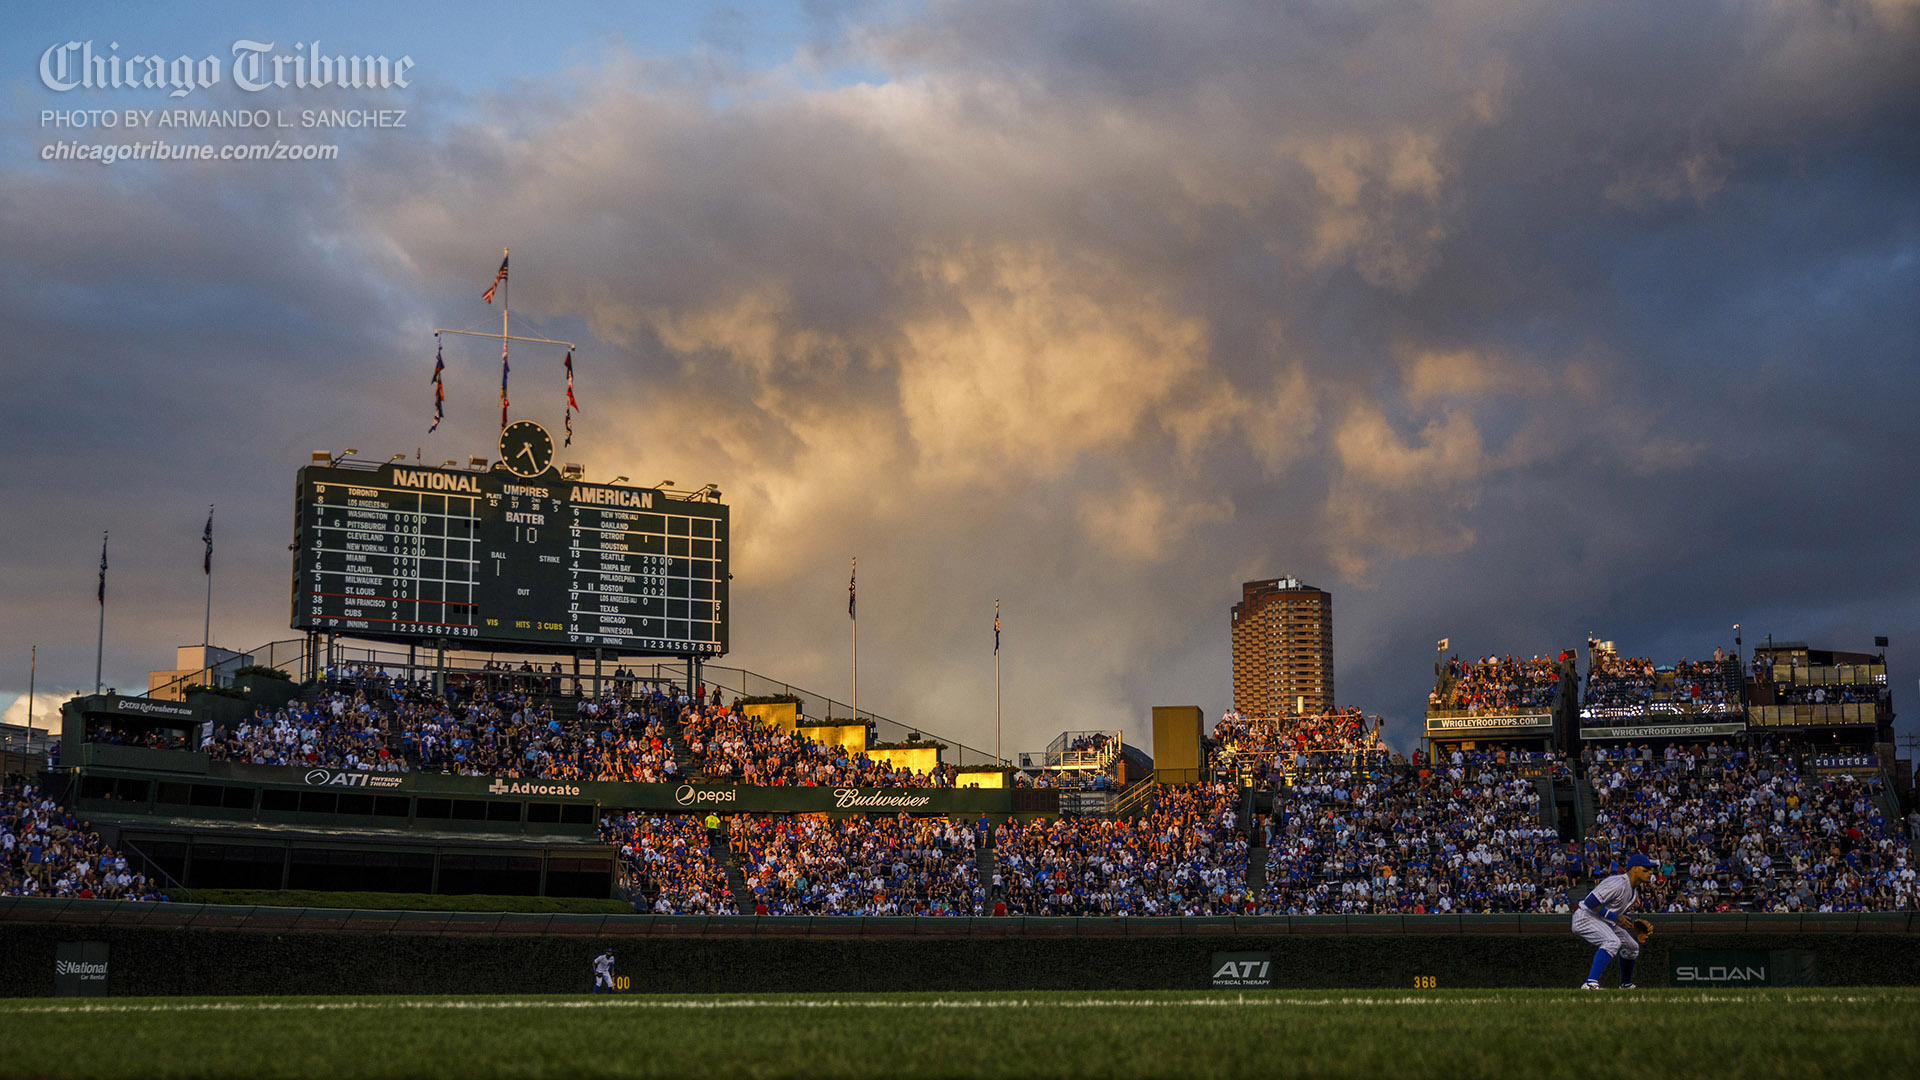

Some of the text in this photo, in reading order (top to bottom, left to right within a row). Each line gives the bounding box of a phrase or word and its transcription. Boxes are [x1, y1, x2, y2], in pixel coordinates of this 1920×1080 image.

[393, 469, 481, 493] NATIONAL
[316, 485, 378, 497] 10 TORONTO
[504, 484, 549, 498] UMPIRES
[318, 496, 324, 504] 8
[570, 486, 652, 508] AMERICAN
[348, 510, 388, 520] WASHINGTON
[574, 508, 579, 516] 6
[506, 512, 544, 525] BATTER
[347, 521, 386, 530] PITTSBURGH
[601, 522, 629, 530] OAKLAND
[347, 532, 384, 542] CLEVELAND
[601, 532, 625, 540] DETROIT
[316, 540, 322, 548] 9
[346, 543, 360, 551] NEW
[600, 543, 628, 551] HOUSTON
[346, 554, 366, 562] MIAMI
[540, 555, 560, 563] STRIKE
[572, 550, 580, 558] 13
[601, 553, 625, 561] SEATTLE
[316, 562, 321, 570] 6
[346, 565, 373, 574] ATLANTA
[600, 563, 618, 571] TAMPA
[345, 576, 382, 585] MILWAUKEE
[600, 574, 636, 583] PHILADELPHIA
[315, 584, 321, 592] 11
[356, 587, 375, 596] LOUIS
[600, 584, 623, 592] BOSTON
[357, 599, 385, 608] FRANCISCO
[600, 605, 619, 613] TEXAS
[345, 609, 362, 617] CUBS
[392, 612, 397, 620] 2
[600, 616, 626, 624] CHICAGO
[411, 624, 416, 632] 3
[436, 626, 441, 634] 6
[454, 627, 459, 635] 8
[463, 628, 468, 636] 9
[470, 628, 478, 636] 10
[516, 621, 531, 629] HITS
[544, 623, 563, 631] CUBS
[600, 626, 633, 635] MINNESOTA
[118, 700, 140, 709] Extra
[140, 703, 178, 713] Refreshers
[1442, 718, 1538, 727] WRIGLEYROOFTOPS.COM
[1612, 727, 1713, 736] WRIGLEYROOFTOPS.COM
[330, 773, 369, 786] ATI
[510, 782, 580, 796] Advocate
[697, 789, 736, 804] pepsi
[834, 789, 929, 808] Budweiser
[66, 962, 108, 973] National
[1213, 961, 1270, 978] ATI
[1676, 967, 1765, 980] SLOAN
[1413, 976, 1437, 988] 368
